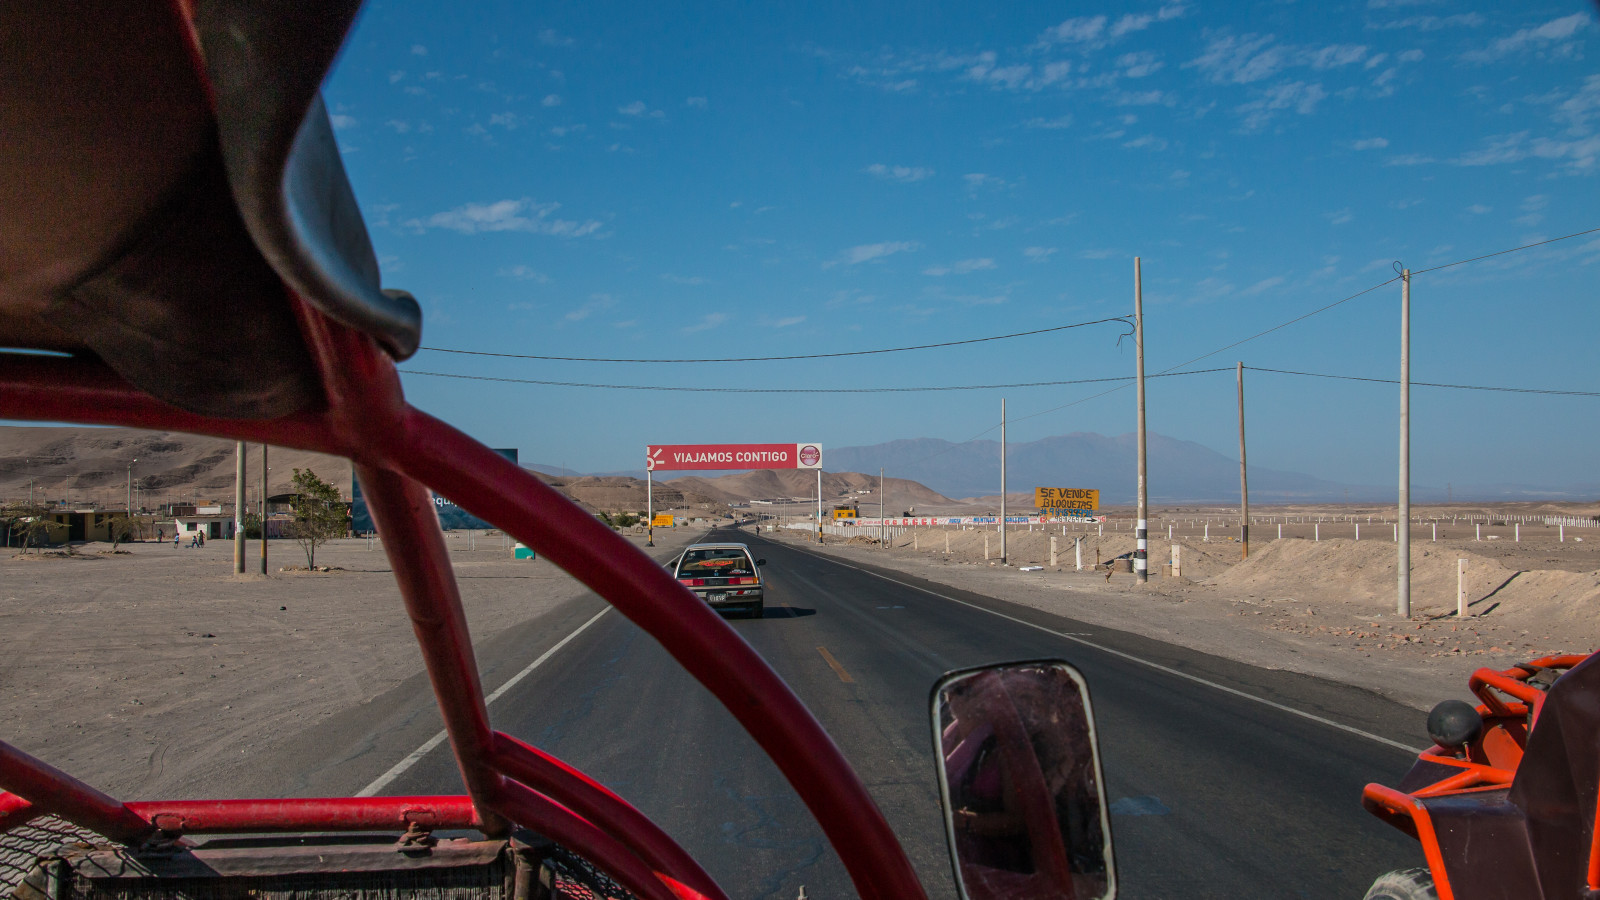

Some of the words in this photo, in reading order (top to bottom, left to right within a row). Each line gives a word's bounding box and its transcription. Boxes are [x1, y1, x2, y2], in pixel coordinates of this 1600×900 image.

[673, 451, 733, 463] VIAJAMOS
[736, 451, 788, 463] CONTIGO
[1040, 488, 1055, 498] SE
[1058, 488, 1094, 499] VENDE
[1040, 498, 1093, 510] BLOQUETAS
